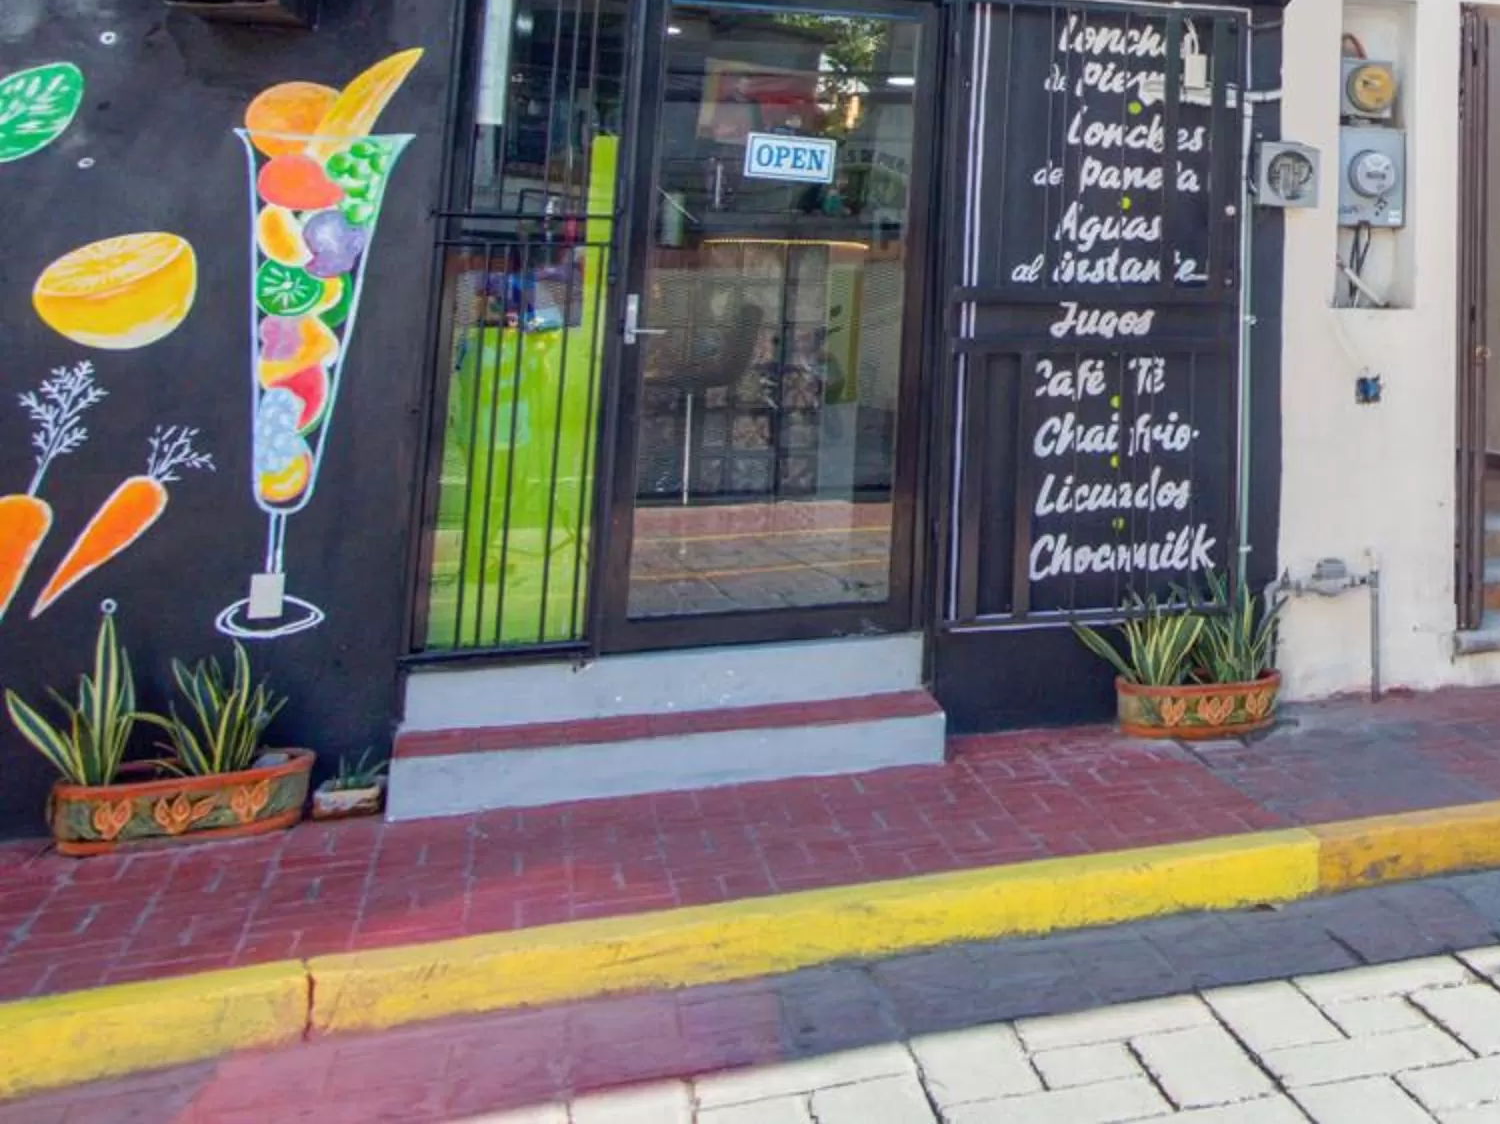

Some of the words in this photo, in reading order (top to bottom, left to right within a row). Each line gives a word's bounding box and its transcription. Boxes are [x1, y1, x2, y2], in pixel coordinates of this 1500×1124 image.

[1058, 15, 1193, 59] Lonch
[757, 143, 827, 171] OPEN
[1033, 162, 1064, 186] de
[1055, 201, 1163, 253] Aguas
[1011, 253, 1045, 283] al
[1050, 301, 1156, 339] Jugos
[1035, 358, 1106, 401] Café
[1033, 412, 1120, 458] Chai
